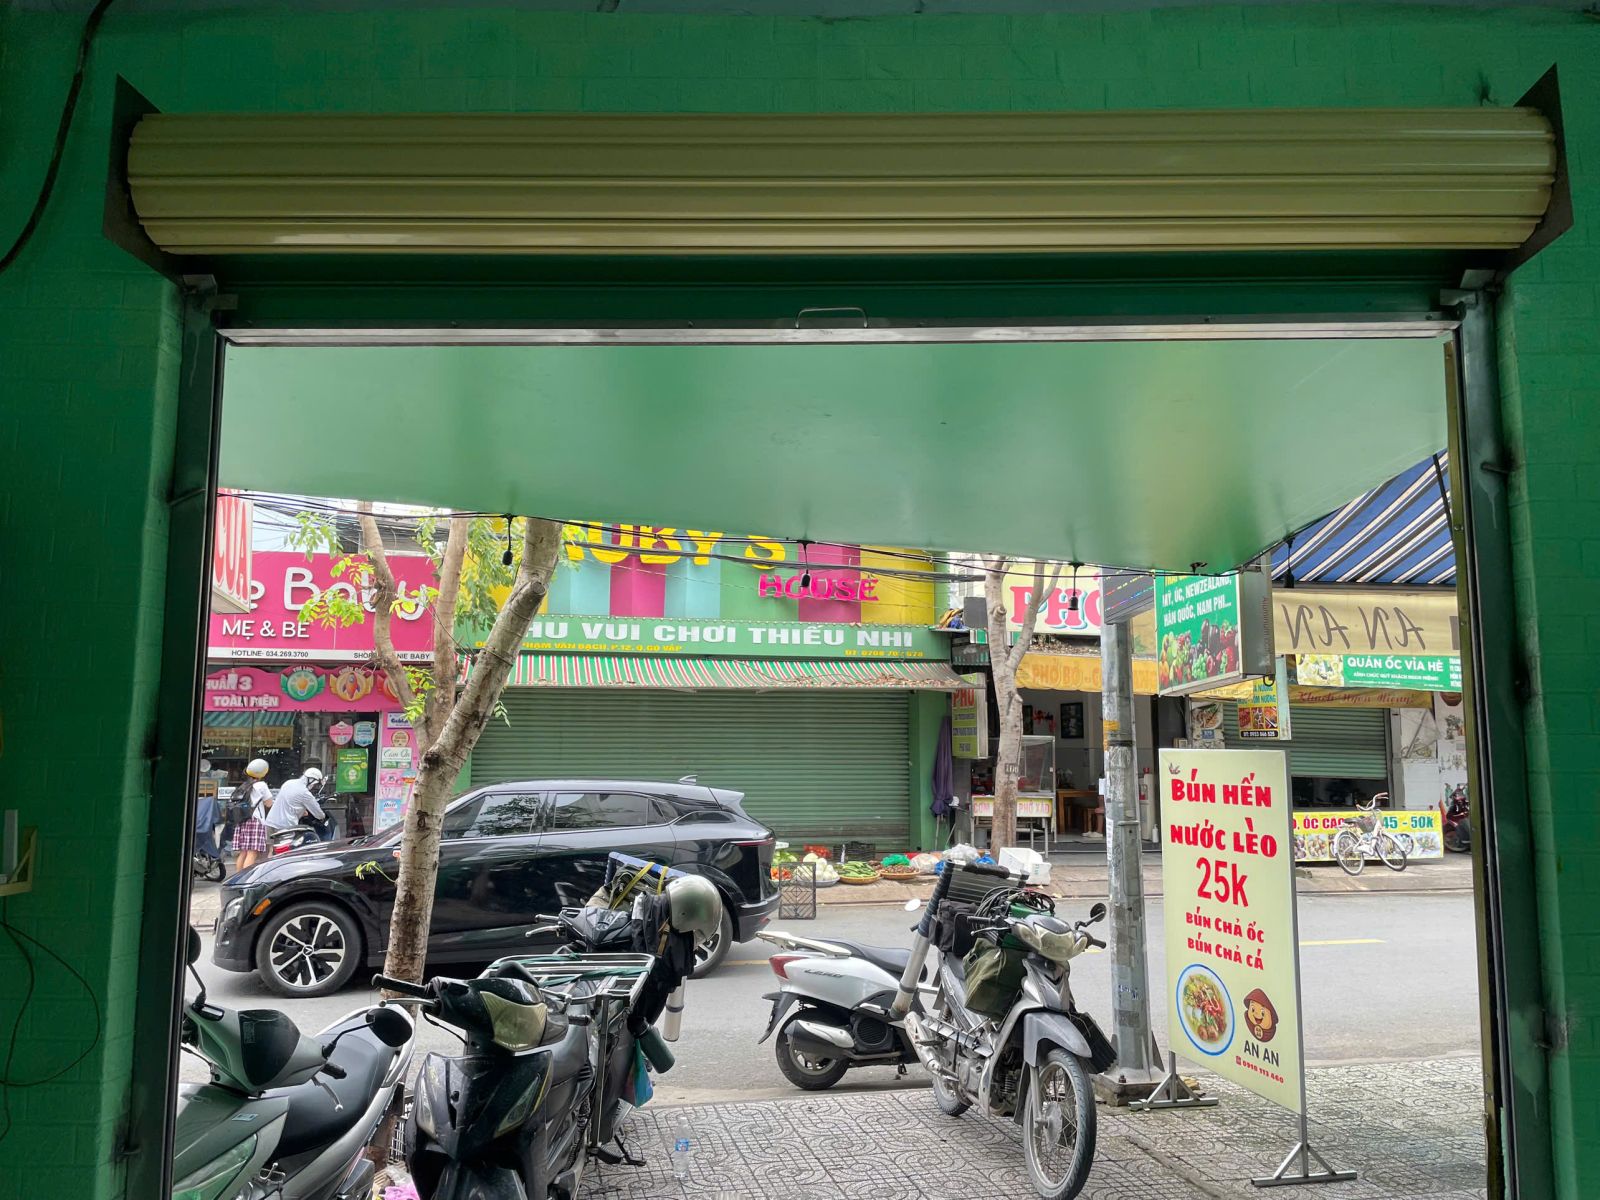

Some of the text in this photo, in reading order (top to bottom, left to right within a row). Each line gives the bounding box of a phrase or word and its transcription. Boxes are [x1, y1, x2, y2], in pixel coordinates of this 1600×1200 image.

[758, 573, 879, 601] HOUSE
[223, 619, 254, 641] MẸ
[260, 621, 276, 638] &
[523, 621, 913, 647] HU VUI CHƠI THIẾU NHI
[410, 654, 431, 662] BABY
[239, 675, 253, 691] 3
[1171, 768, 1272, 808] BÚN HẾN
[1170, 816, 1278, 858] NƯỚC LÈO
[1186, 906, 1264, 943] BÚN CHẢ ỐC
[1187, 931, 1264, 971] BÚN CHẢ CÁ
[1243, 1040, 1280, 1067] AN AN
